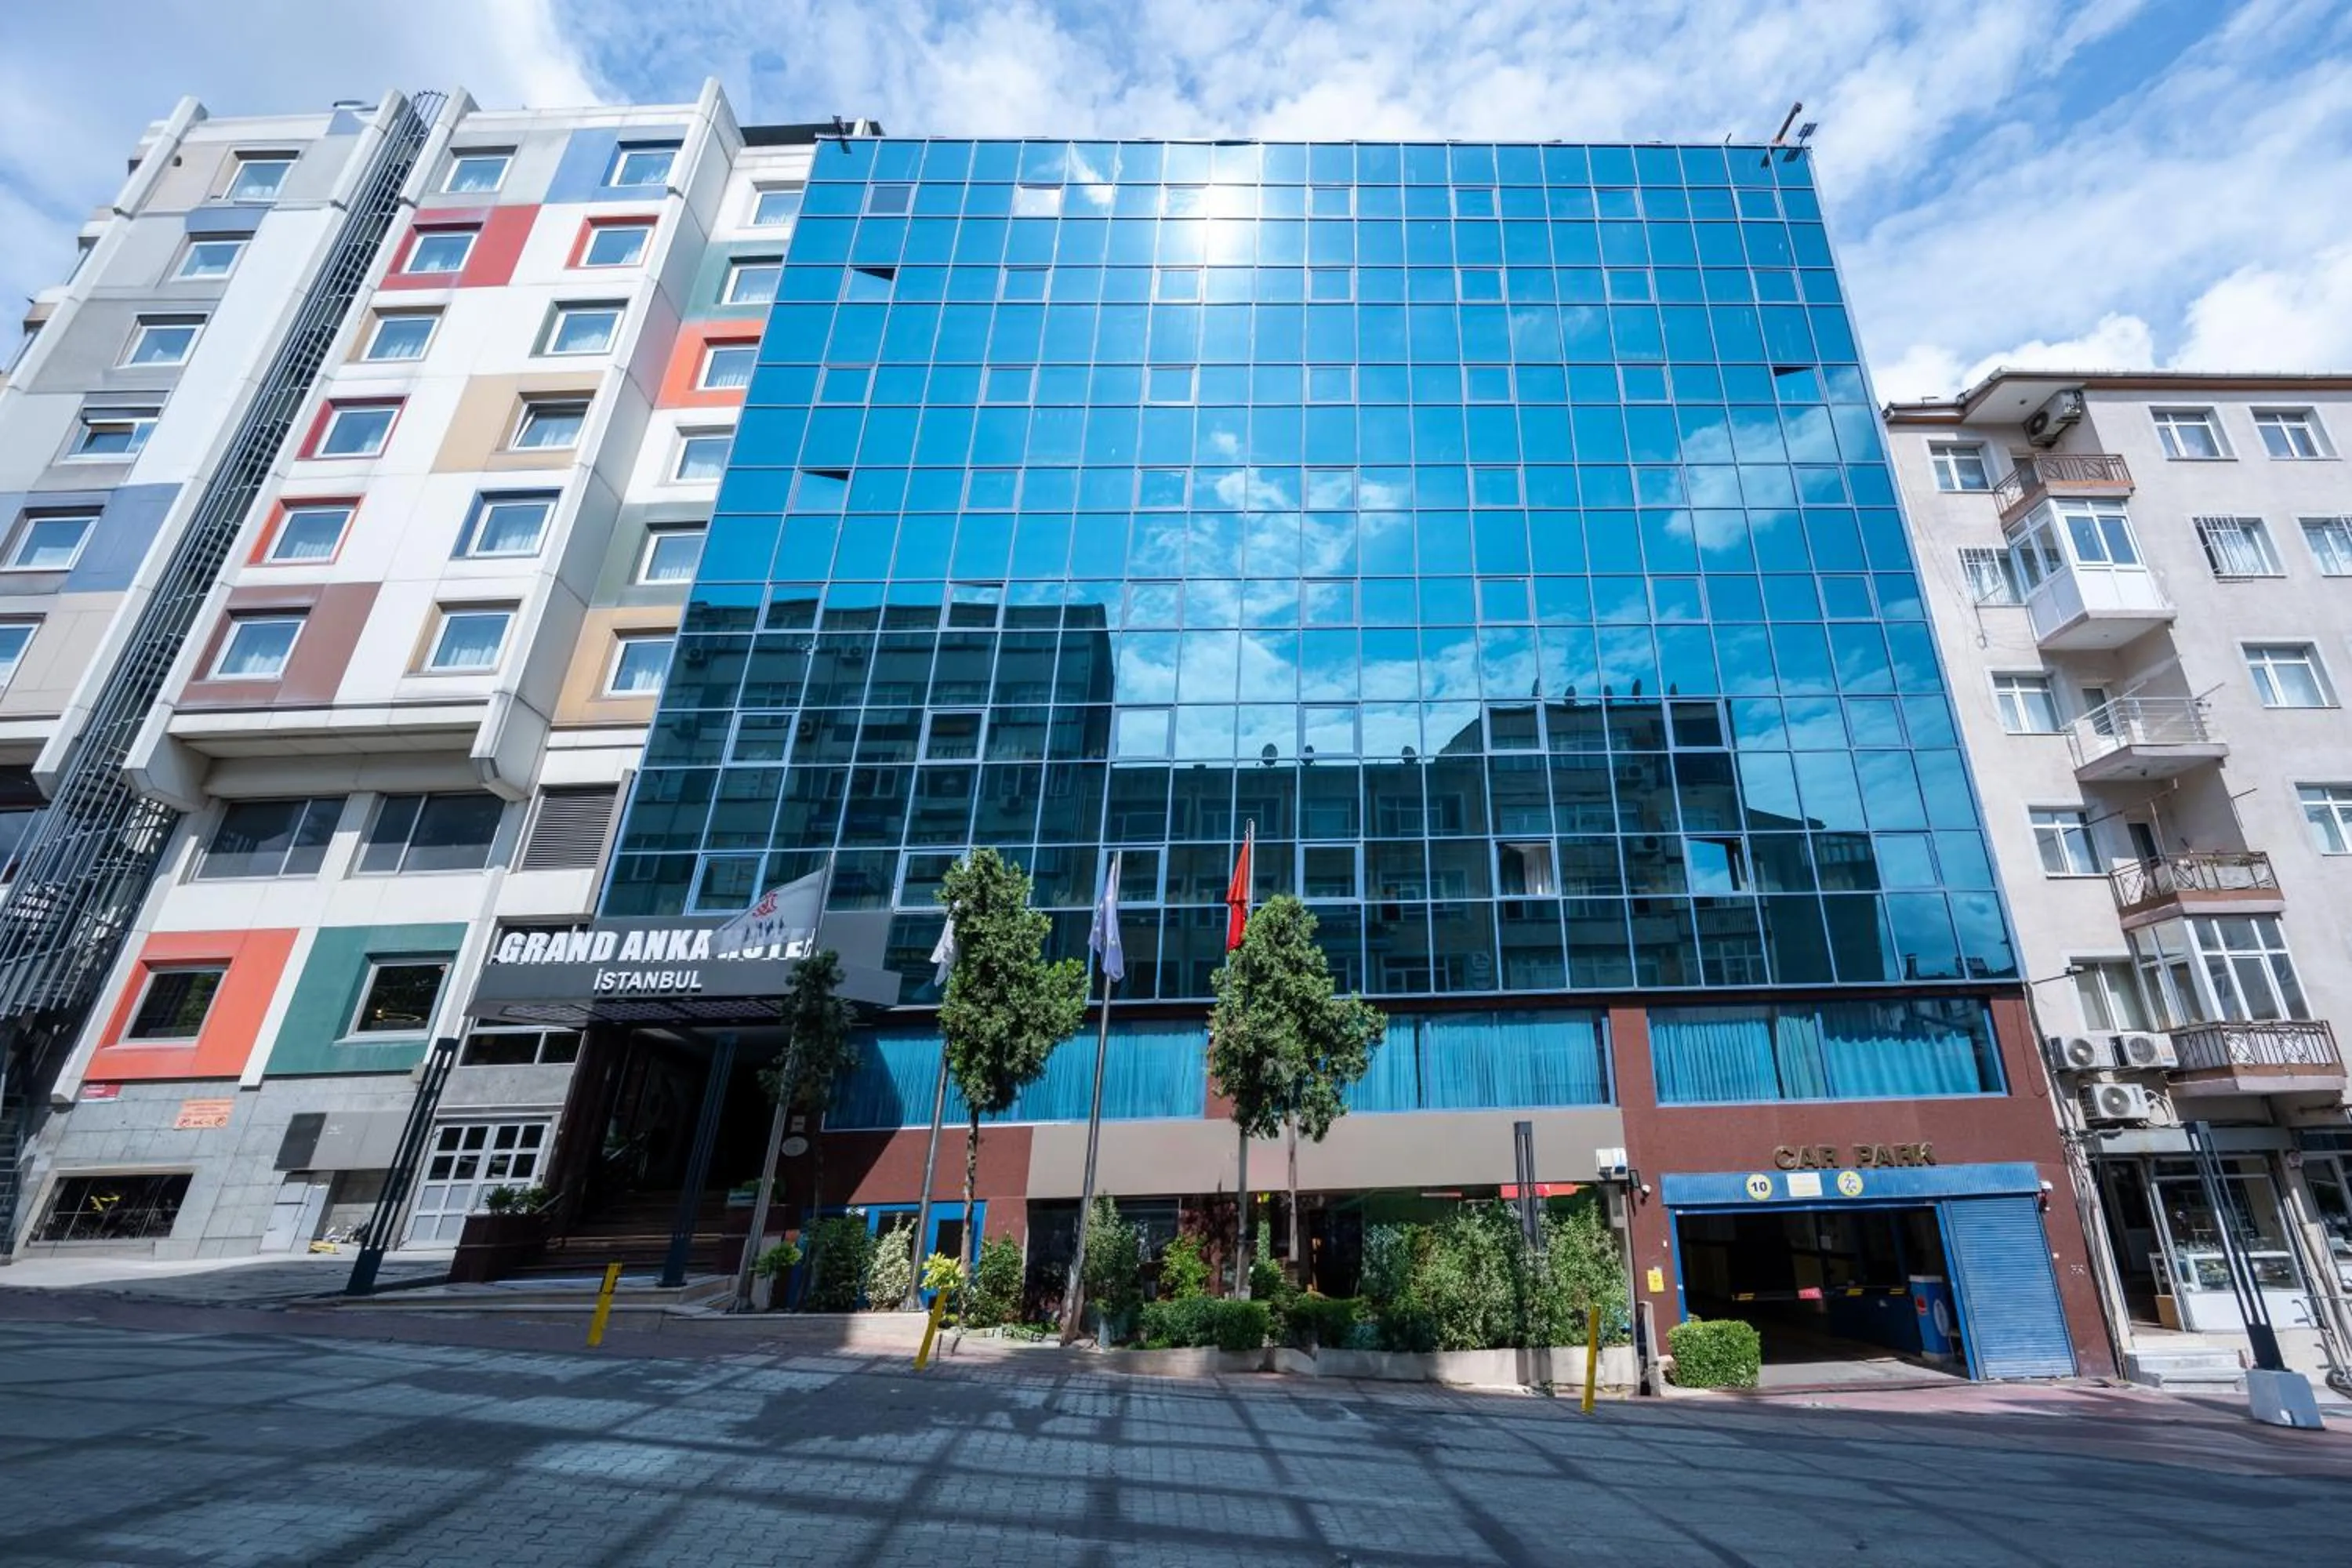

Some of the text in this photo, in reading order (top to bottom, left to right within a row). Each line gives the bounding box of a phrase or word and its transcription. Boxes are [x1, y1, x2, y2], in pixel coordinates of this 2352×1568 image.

[496, 931, 619, 964] GRAND
[618, 929, 713, 963] ANKA
[593, 967, 702, 992] İSTANBUL
[1773, 1142, 1936, 1170] CAR PARK
[1751, 1181, 1768, 1193] 10
